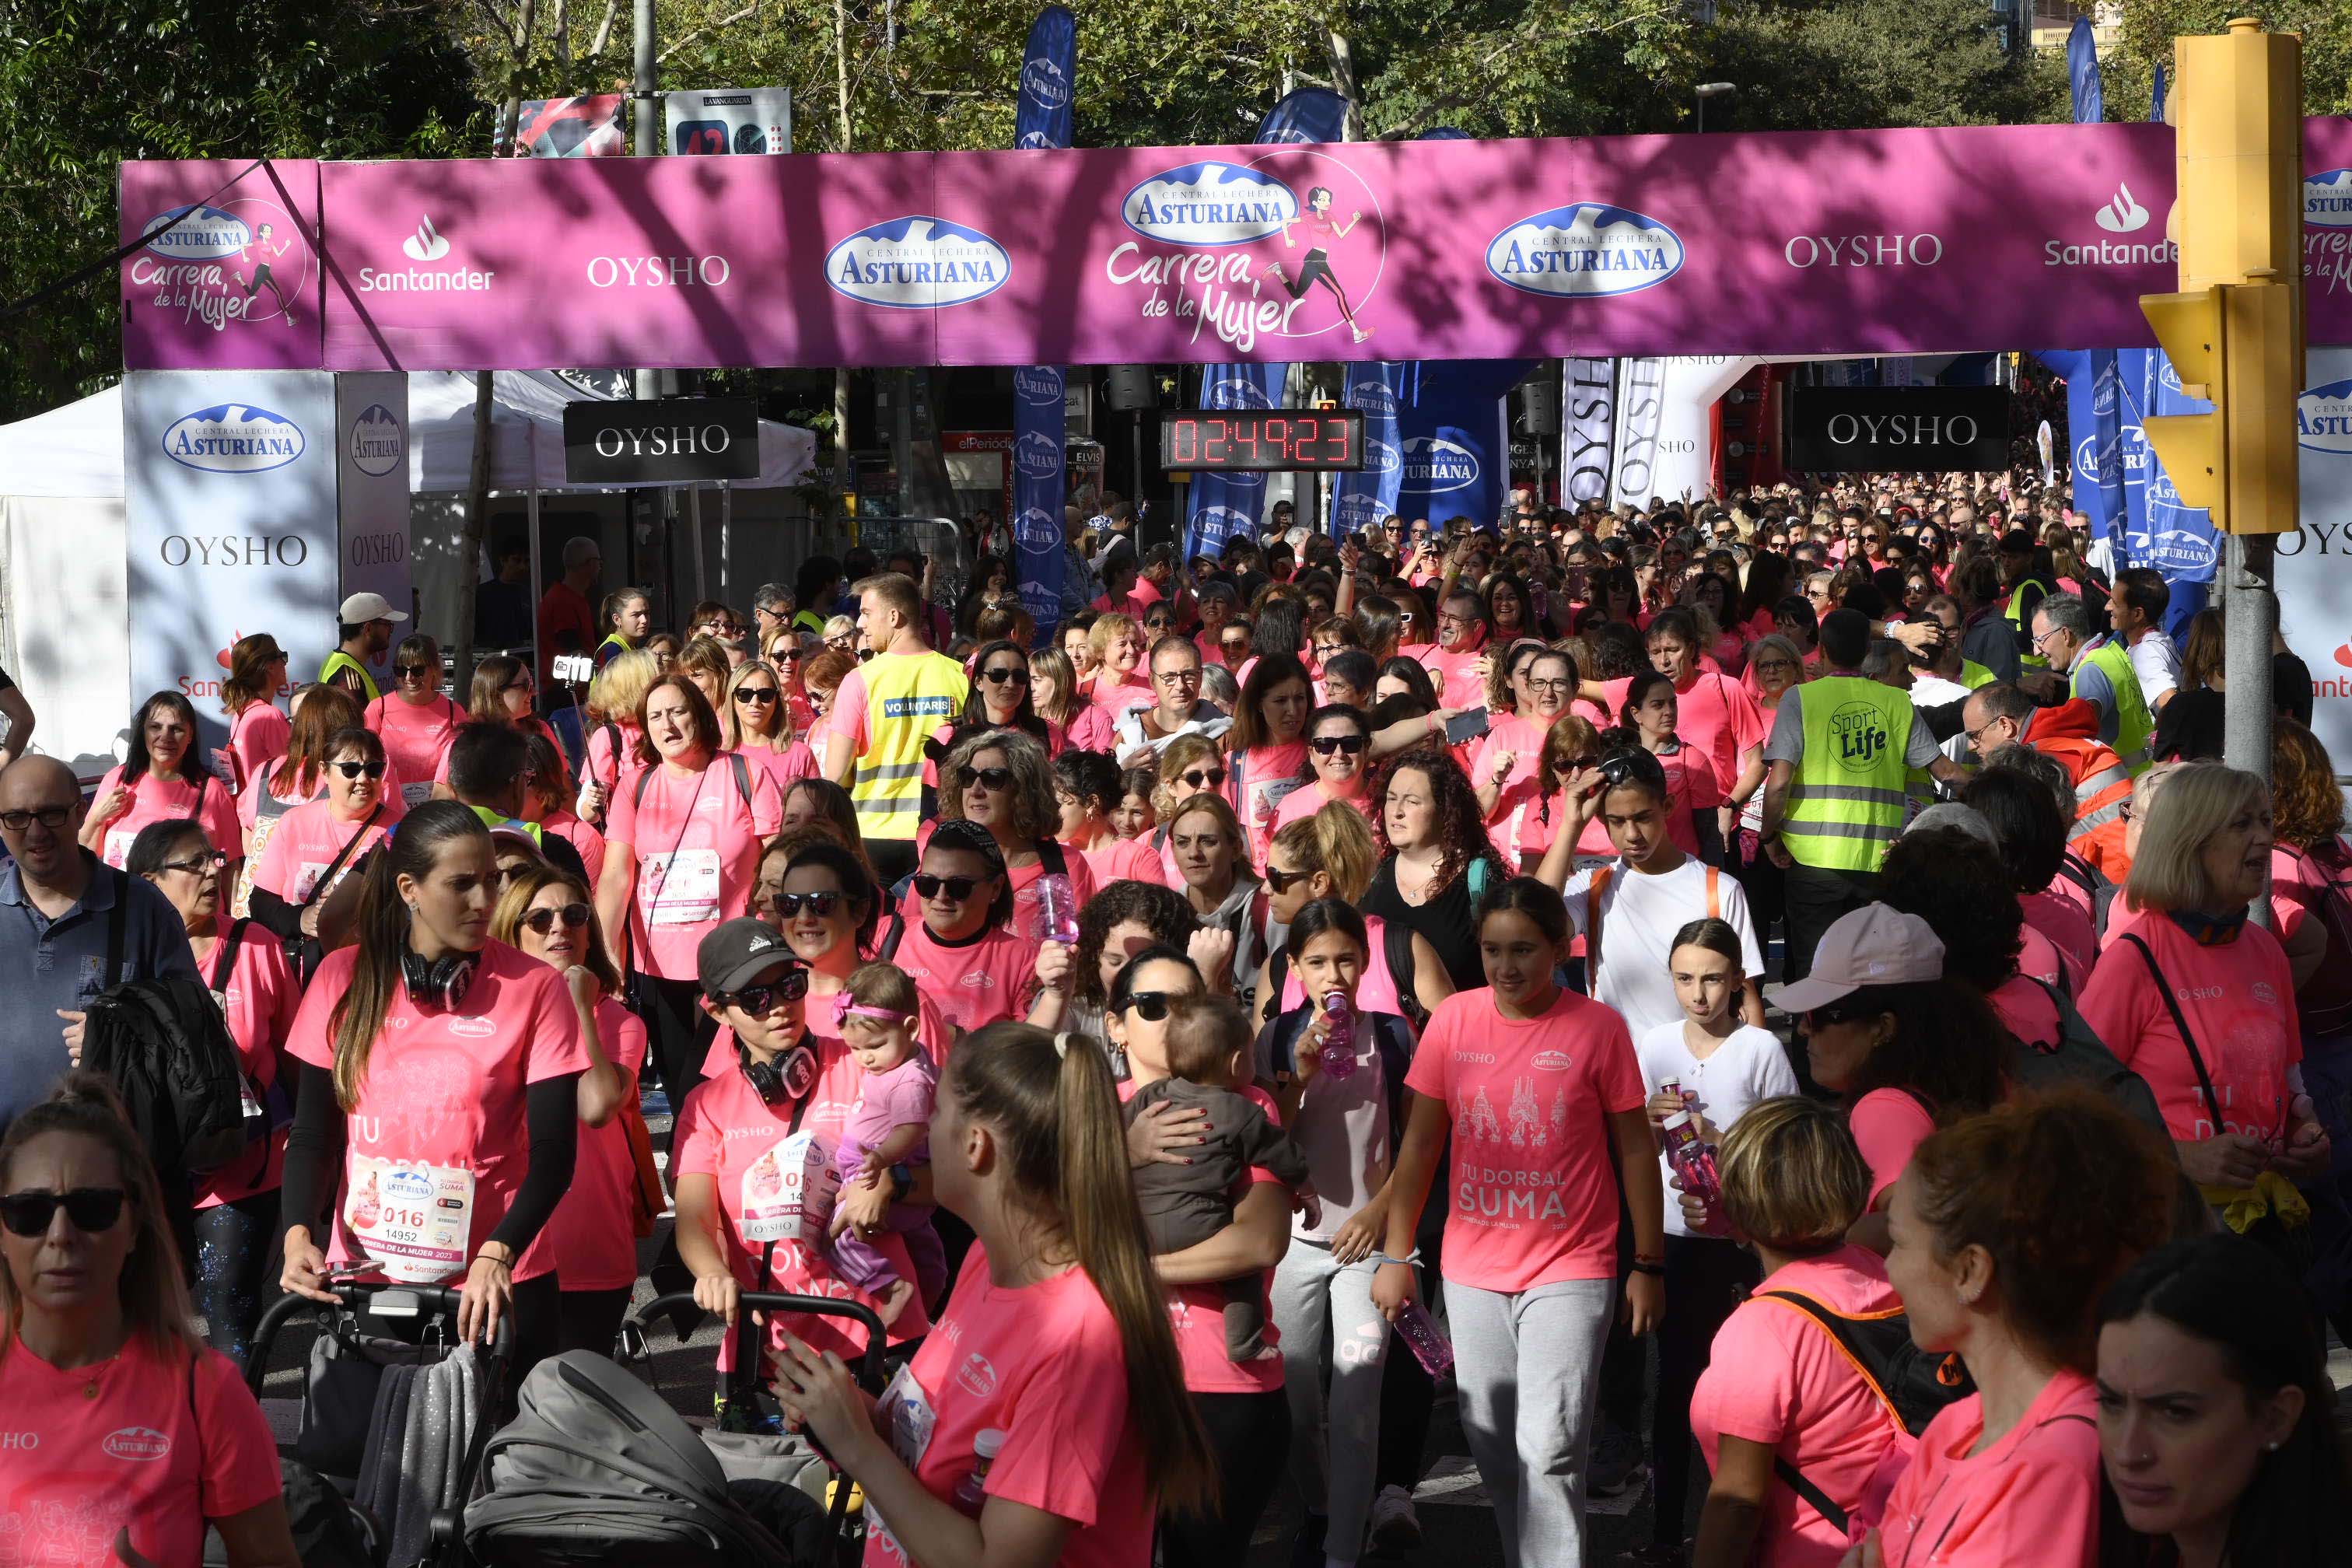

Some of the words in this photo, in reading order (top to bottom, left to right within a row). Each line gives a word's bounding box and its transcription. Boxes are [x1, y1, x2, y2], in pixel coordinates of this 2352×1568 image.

[1162, 190, 1215, 199] CENTRAL
[1222, 189, 1279, 198] LECHERA
[2303, 198, 2352, 212] STUR
[1134, 194, 1283, 226] ASTURIANA
[866, 248, 925, 257] CENTRAL
[931, 247, 990, 257] LECHERA
[1531, 236, 1594, 247] CENTRAL
[1598, 233, 1662, 245] LECHERA
[1785, 233, 1943, 268] OYSHO
[2044, 239, 2179, 266] Santande
[131, 256, 222, 286] Carrera
[838, 250, 996, 284] ASTURIANA
[1106, 241, 1251, 285] Carrera
[1501, 240, 1669, 275] ASTURIANA
[359, 267, 495, 292] Santander
[586, 255, 730, 288] OYSHO
[154, 287, 171, 307] de
[175, 286, 187, 307] la
[184, 282, 257, 331] Mujer
[1142, 286, 1169, 317] de
[1175, 285, 1195, 317] la
[1190, 278, 1306, 353] Mujer
[1350, 397, 1395, 413] ASTURIAN
[595, 424, 730, 457] OYSHO
[1174, 418, 1348, 462] 02:49:23
[1570, 357, 1610, 506] OYSH
[1619, 357, 1659, 497] OYSH
[1826, 413, 1979, 446] OYSHO
[173, 429, 295, 456] ASTURIANA
[354, 433, 400, 459] ASTURIANA
[959, 436, 1013, 450] elPeriódi
[1076, 452, 1100, 463] ELVIS
[160, 535, 308, 567] OYSHO
[352, 531, 404, 567] OYSHO
[885, 701, 948, 713] VOLUNTARIS
[1832, 708, 1878, 735] Sport
[1841, 726, 1887, 761] Life
[903, 968, 929, 978] SHO
[2178, 985, 2223, 1000] OSHO
[1454, 1051, 1496, 1065] OYSHO
[353, 1116, 380, 1143] TU
[439, 1182, 464, 1192] SUMA
[1461, 1162, 1477, 1181] TU
[1483, 1169, 1566, 1187] DORSAL
[1458, 1182, 1567, 1220] SUMA
[383, 1207, 424, 1227] 016
[386, 1229, 418, 1243] 14952
[408, 1248, 433, 1257] MUJER
[414, 1264, 454, 1275] Santander
[107, 1437, 167, 1453] ASTURIANA
